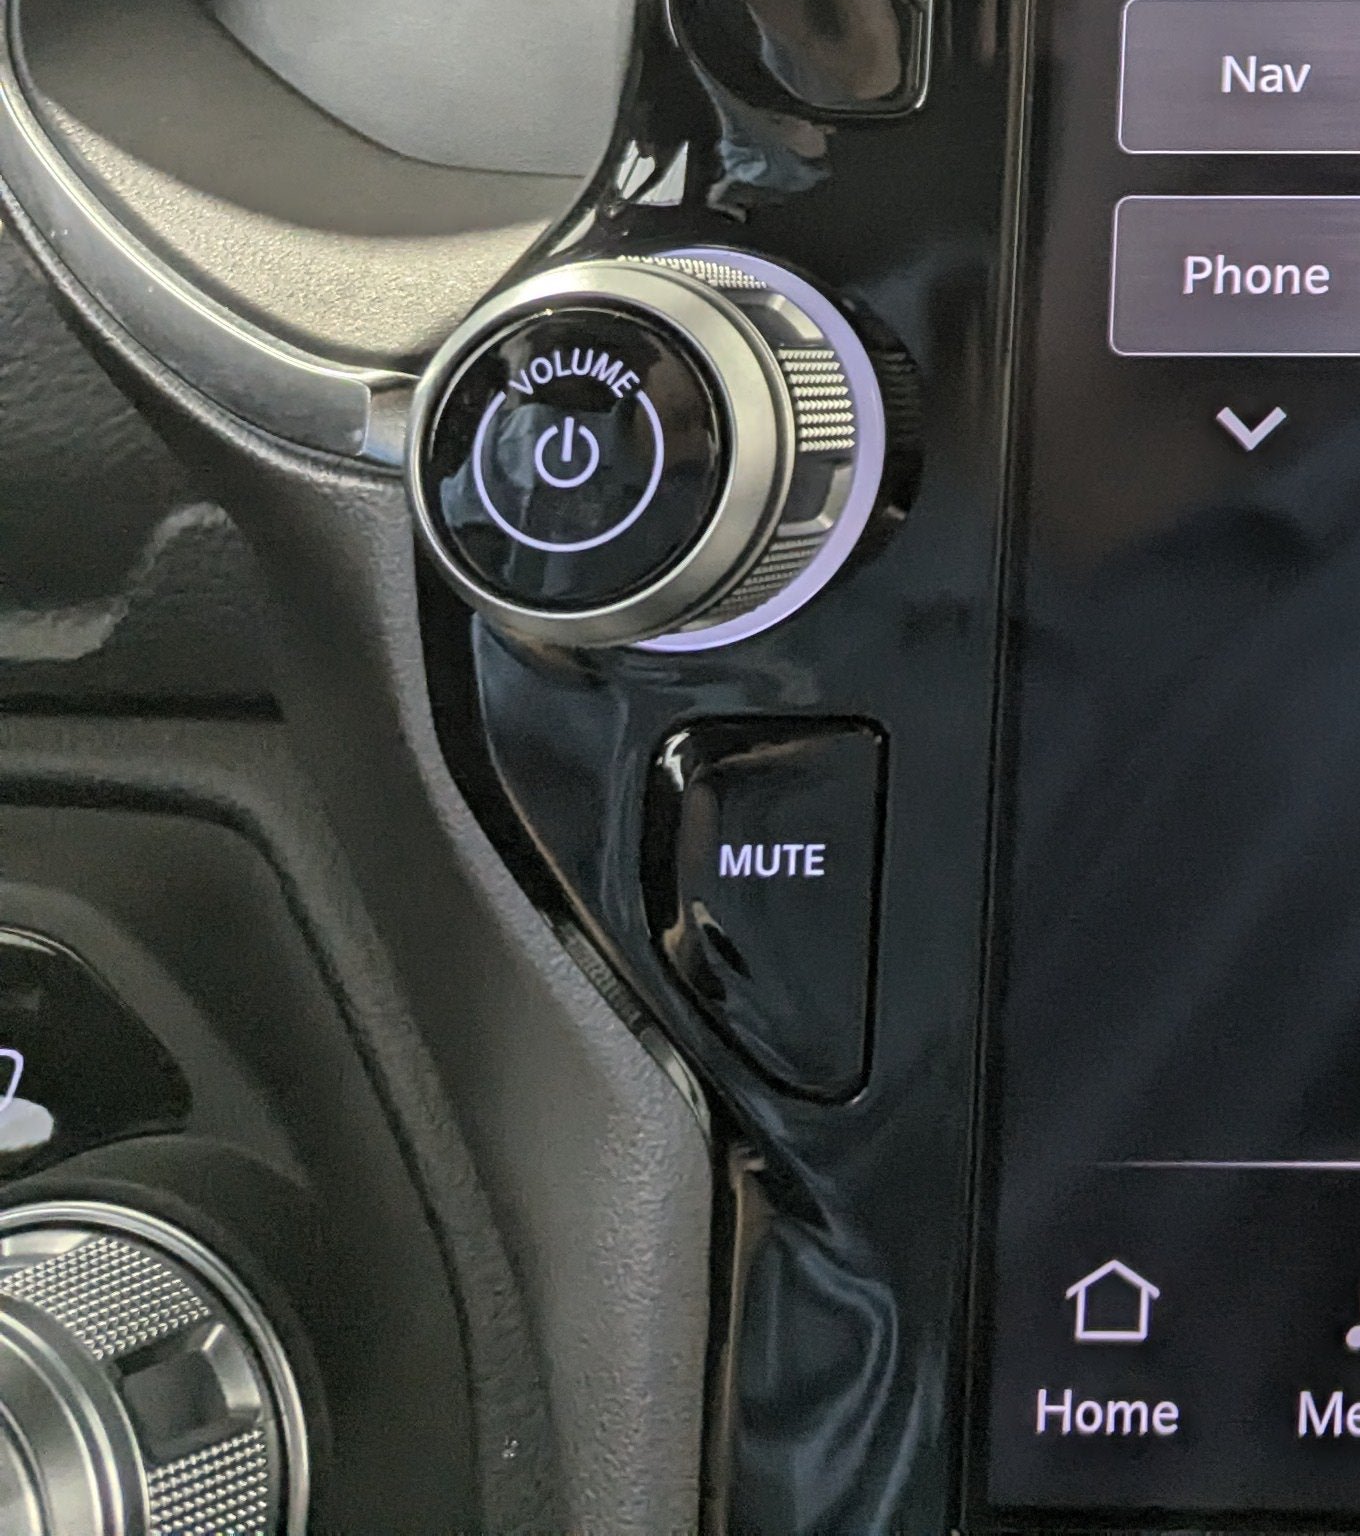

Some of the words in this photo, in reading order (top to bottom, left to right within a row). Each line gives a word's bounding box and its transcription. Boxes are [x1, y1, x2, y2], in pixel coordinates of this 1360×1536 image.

[1222, 55, 1311, 93] Nav
[1183, 254, 1330, 294] Phone
[508, 347, 641, 399] VOLUME
[720, 843, 826, 877] MUTE
[1036, 1388, 1179, 1435] Home
